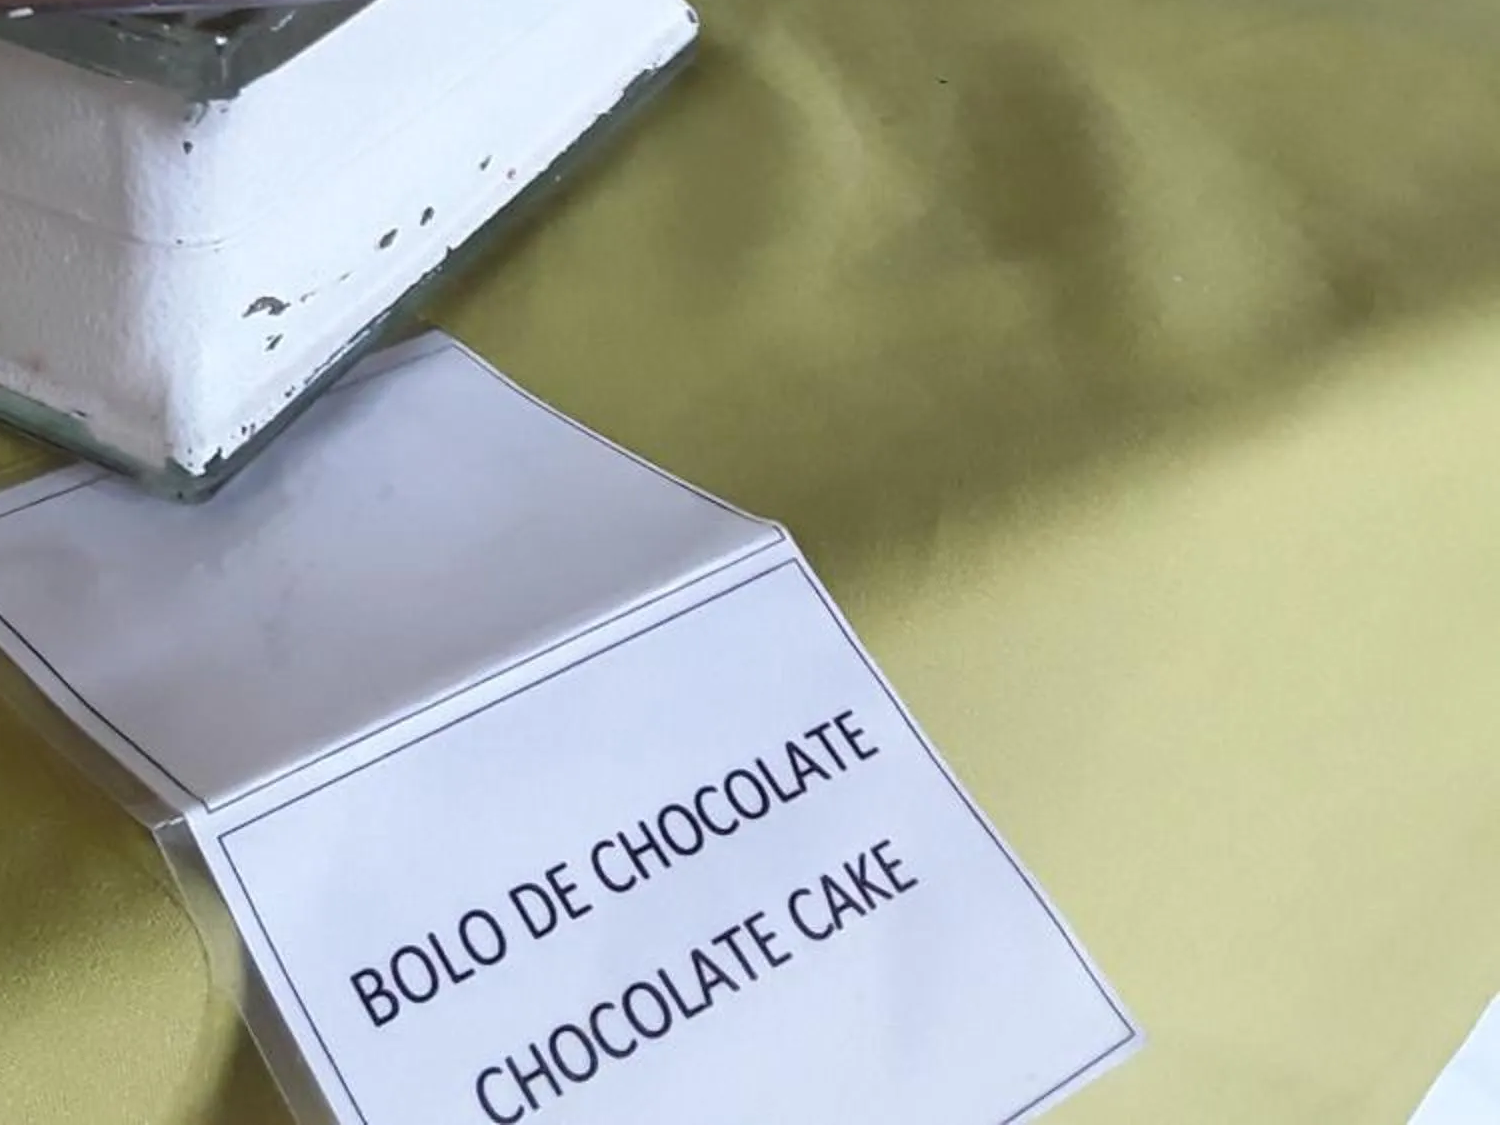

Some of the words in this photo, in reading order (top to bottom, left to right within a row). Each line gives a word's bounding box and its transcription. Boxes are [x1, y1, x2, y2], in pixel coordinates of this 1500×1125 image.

[349, 908, 508, 1027] BOLO
[508, 861, 592, 939] DE
[590, 710, 879, 893] CHOCOLATE
[475, 911, 792, 1125] CHOCOLATE
[787, 839, 918, 942] CAKE
